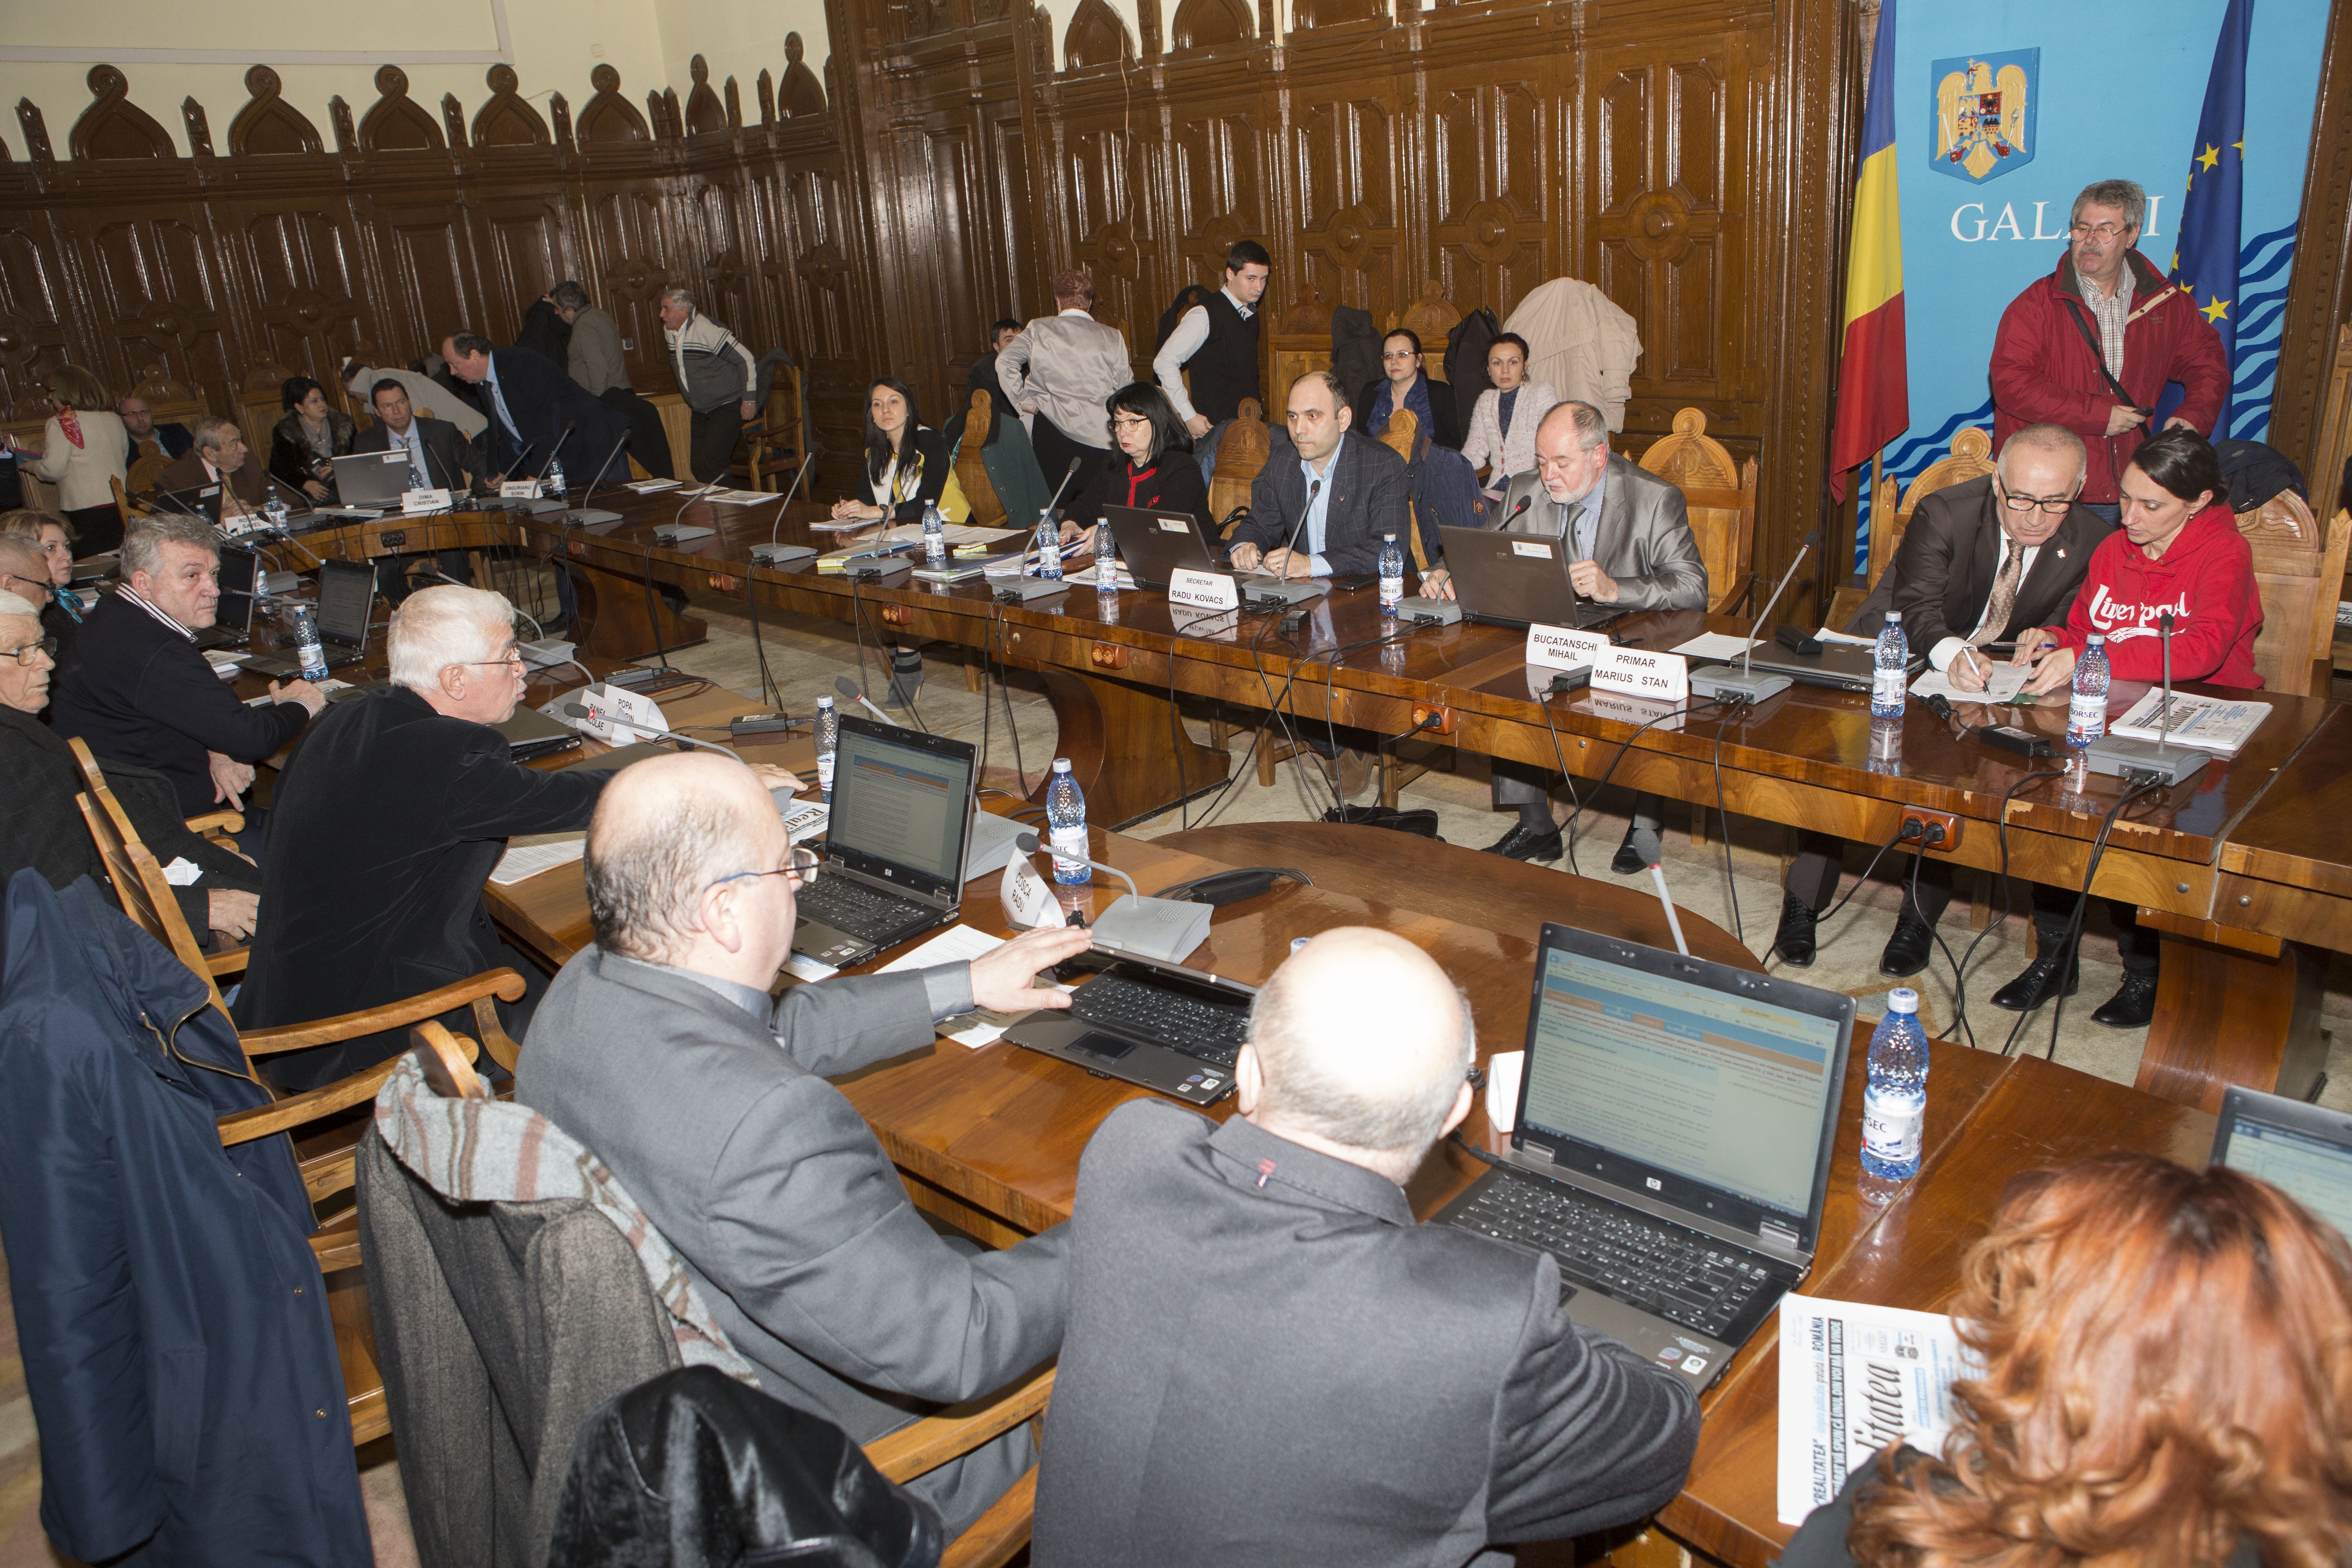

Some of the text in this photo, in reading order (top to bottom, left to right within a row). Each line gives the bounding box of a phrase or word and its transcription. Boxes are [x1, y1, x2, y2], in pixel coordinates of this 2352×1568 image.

[1951, 196, 2164, 242] GALI
[1186, 578, 1213, 586] SECRETAR
[1172, 590, 1223, 605] RADU KOVACS
[1534, 634, 1597, 652] BUCATANSCHI
[1548, 648, 1578, 661] MIHAIL
[1616, 654, 1656, 668] PRIMAR
[1594, 669, 1668, 688] MARIUS STAN
[618, 698, 632, 711] POPA
[2070, 707, 2098, 718] BORSEC
[1015, 872, 1032, 900] COSCA
[1012, 889, 1025, 913] RADU
[1830, 1321, 1841, 1343] VINDE
[1831, 1344, 1841, 1354] VA
[1831, 1367, 1843, 1381] VOI
[1831, 1381, 1844, 1396] DIN
[1831, 1429, 1845, 1452] SPUN
